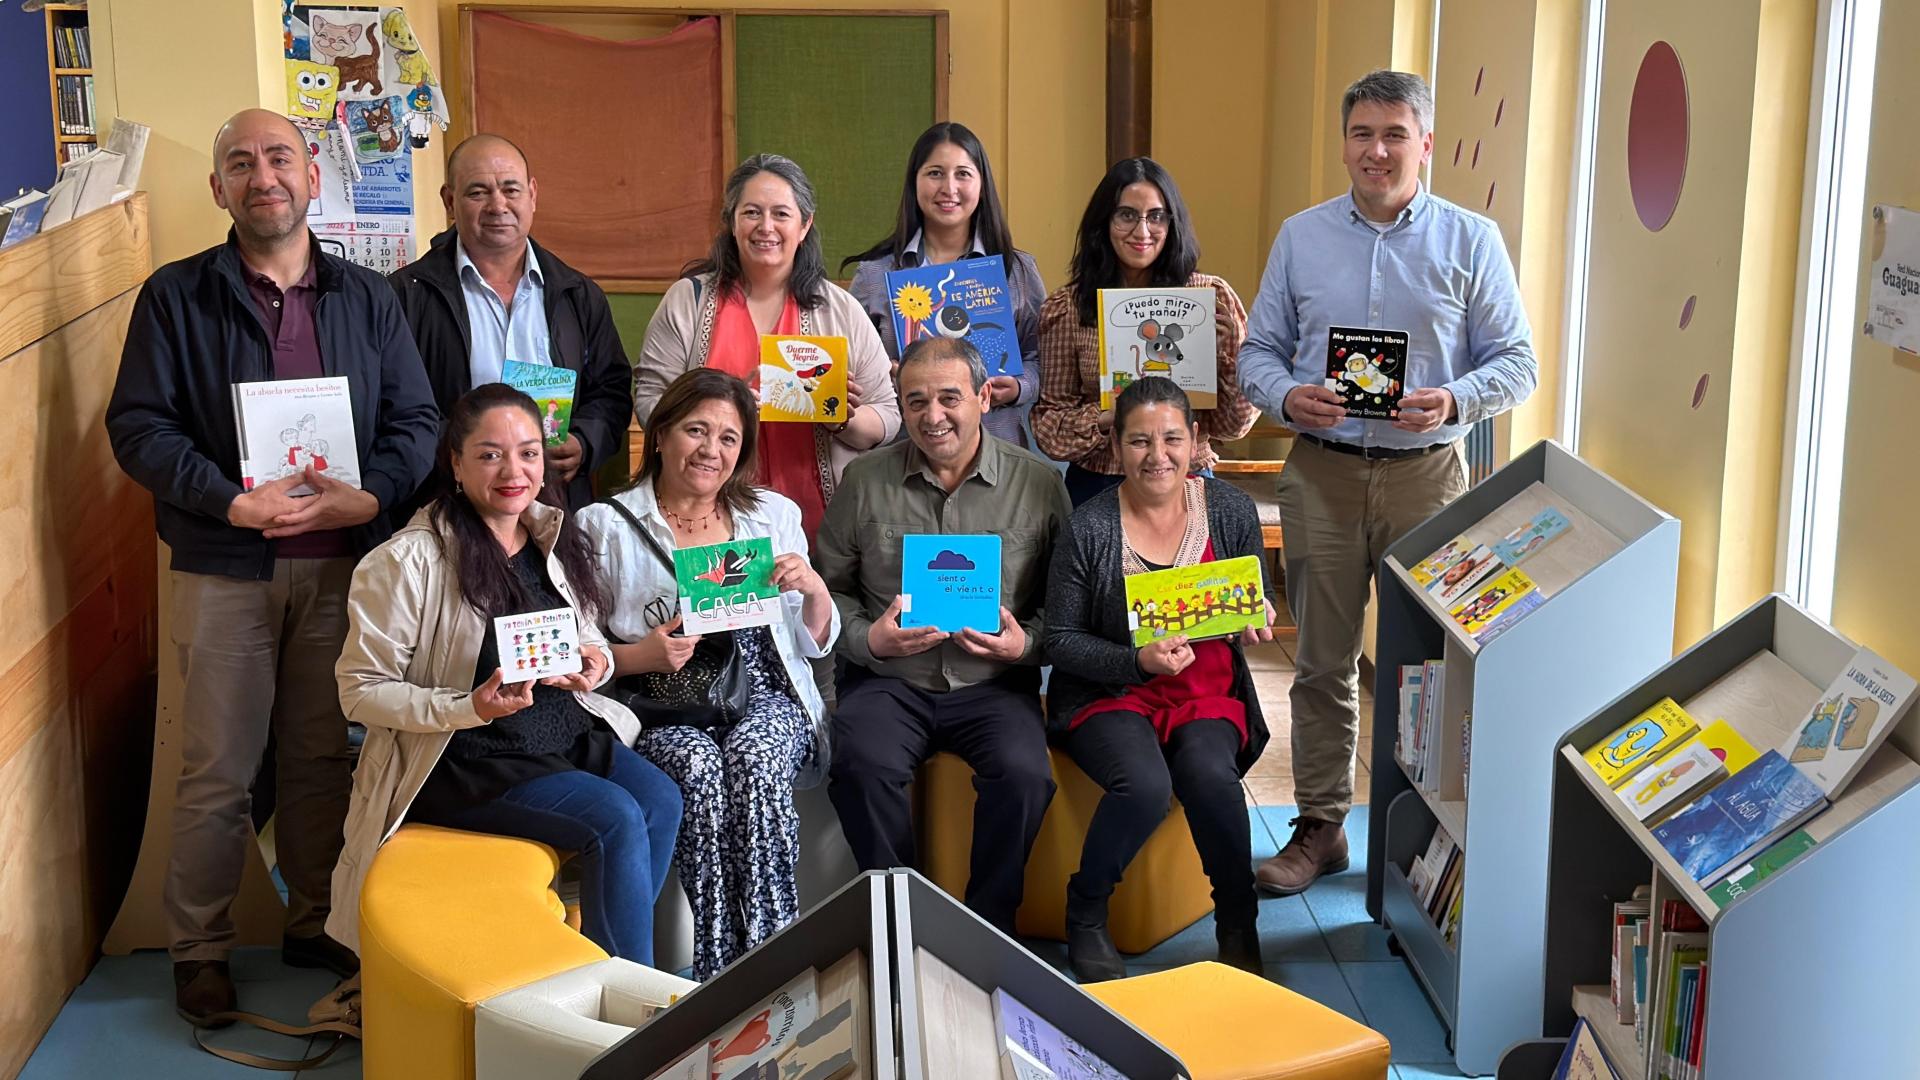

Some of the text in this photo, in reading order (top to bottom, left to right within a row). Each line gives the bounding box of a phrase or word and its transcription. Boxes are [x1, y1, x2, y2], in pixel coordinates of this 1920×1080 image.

[1882, 267, 1920, 296] Guagua
[951, 292, 963, 302] DE
[964, 297, 998, 310] LATINA
[1124, 296, 1197, 314] ¿Puedo mirar
[1132, 306, 1188, 320] tu pañal?
[786, 345, 817, 354] Duerme
[792, 353, 819, 362] Negrito
[525, 378, 545, 387] VERDE
[246, 384, 342, 397] La abuela necesita besitos
[1364, 408, 1386, 417] Browne
[937, 574, 966, 582] siento
[1175, 582, 1193, 590] diez
[696, 592, 764, 619] CACA
[1847, 667, 1856, 678] LA
[1856, 672, 1868, 687] HORA
[1866, 677, 1876, 692] DE
[1878, 688, 1896, 706] SIESTA
[1735, 800, 1762, 822] AGUA
[771, 991, 796, 1046] Cinco zorritos
